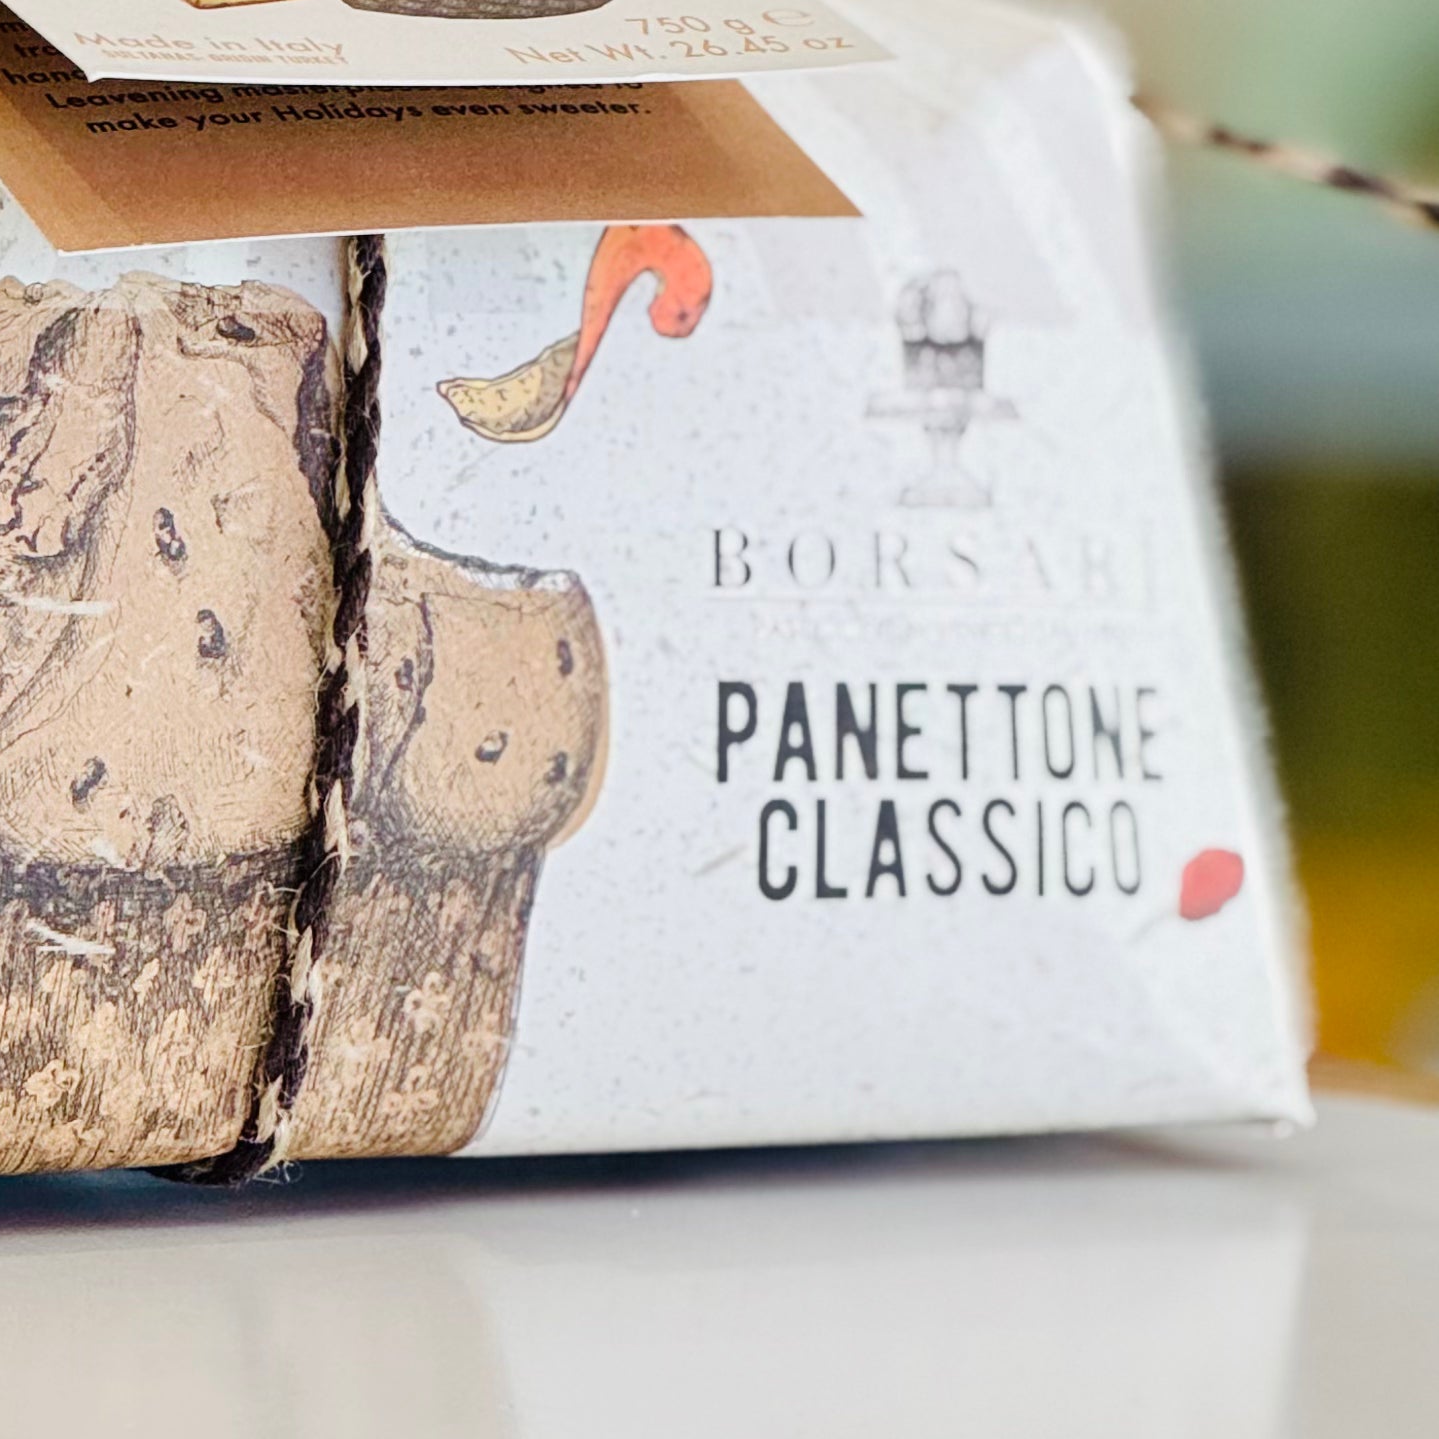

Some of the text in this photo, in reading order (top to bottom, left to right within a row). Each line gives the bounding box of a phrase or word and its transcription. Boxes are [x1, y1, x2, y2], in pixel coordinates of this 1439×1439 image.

[625, 15, 712, 35] 750
[723, 17, 756, 35] g
[73, 31, 344, 56] Made in Italy
[504, 35, 854, 64] Net Wt. 26.45 oz
[45, 85, 224, 110] Leavening
[86, 101, 653, 133] make your Holidays even sweeter.
[716, 680, 1164, 783] PANETTONE
[757, 798, 1143, 901] CLASSICO
